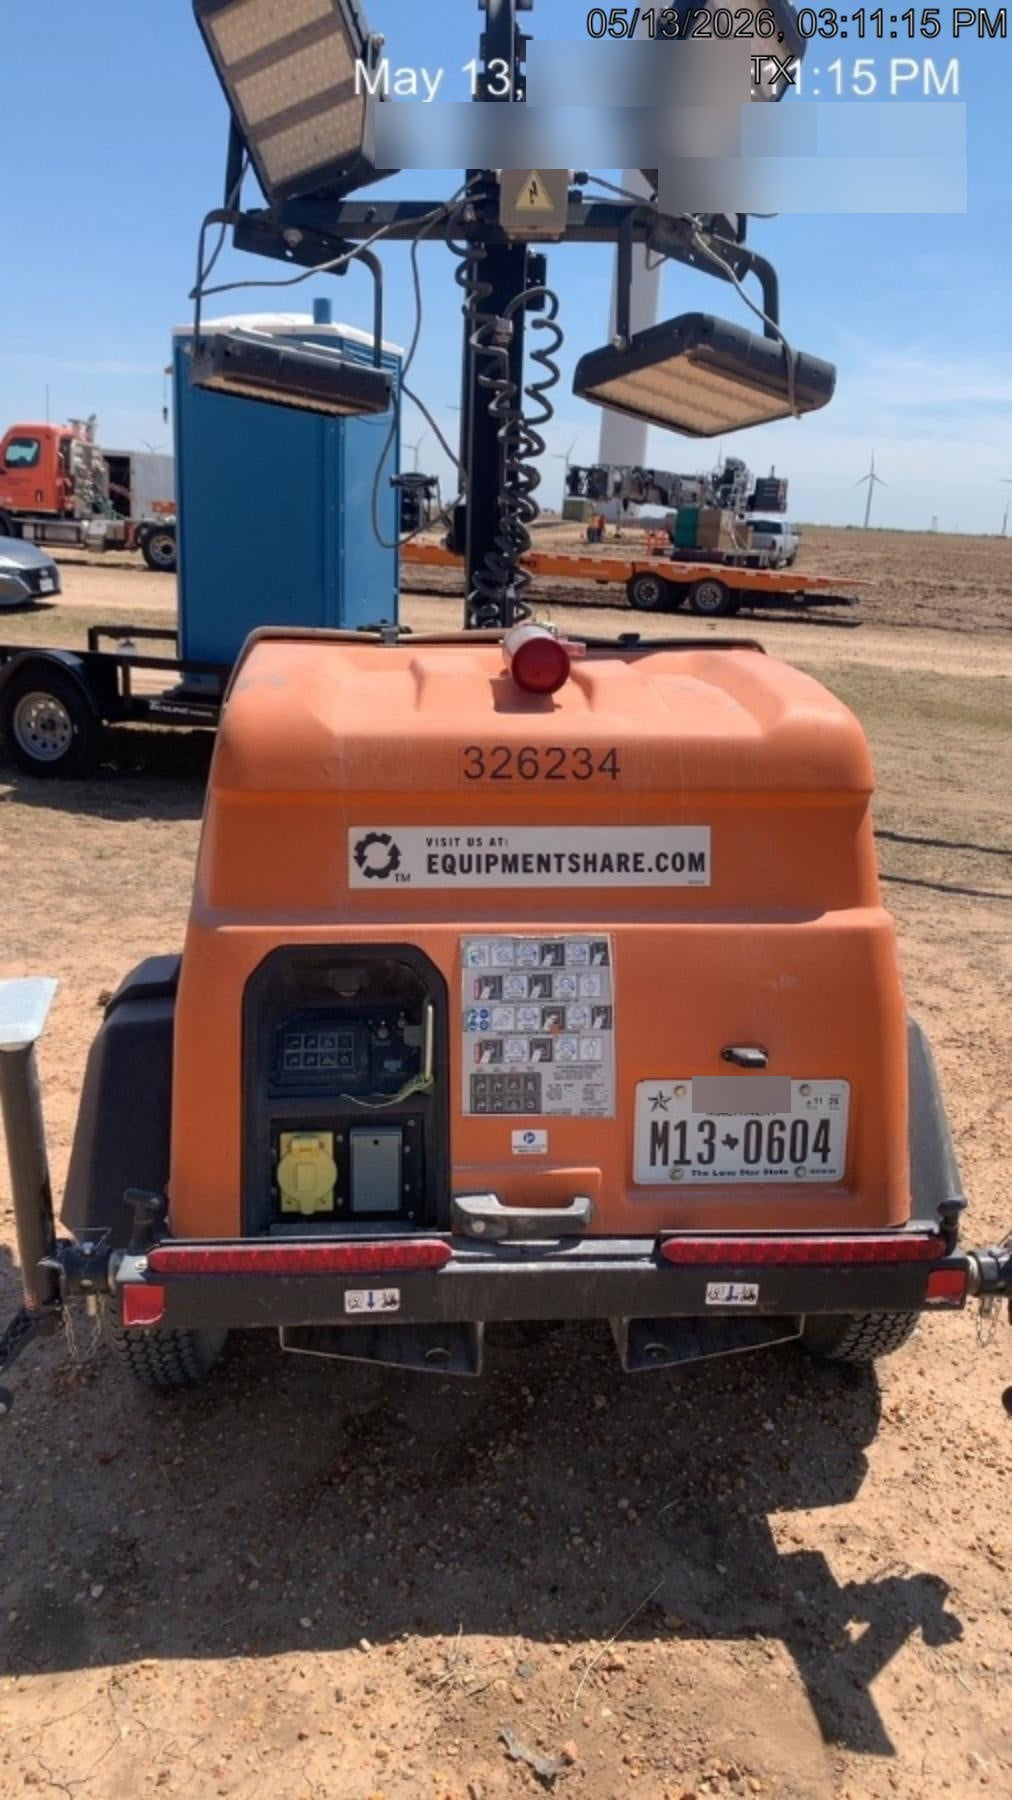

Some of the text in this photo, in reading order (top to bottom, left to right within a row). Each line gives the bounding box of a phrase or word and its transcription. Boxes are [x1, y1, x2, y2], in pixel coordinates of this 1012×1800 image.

[463, 747, 621, 780] 326234
[426, 837, 461, 847] VISIT
[467, 837, 483, 847] US
[427, 852, 706, 876] EQUIPMENTSHARE.COM
[650, 1118, 832, 1166] M13 0604
[691, 1169, 709, 1177] The
